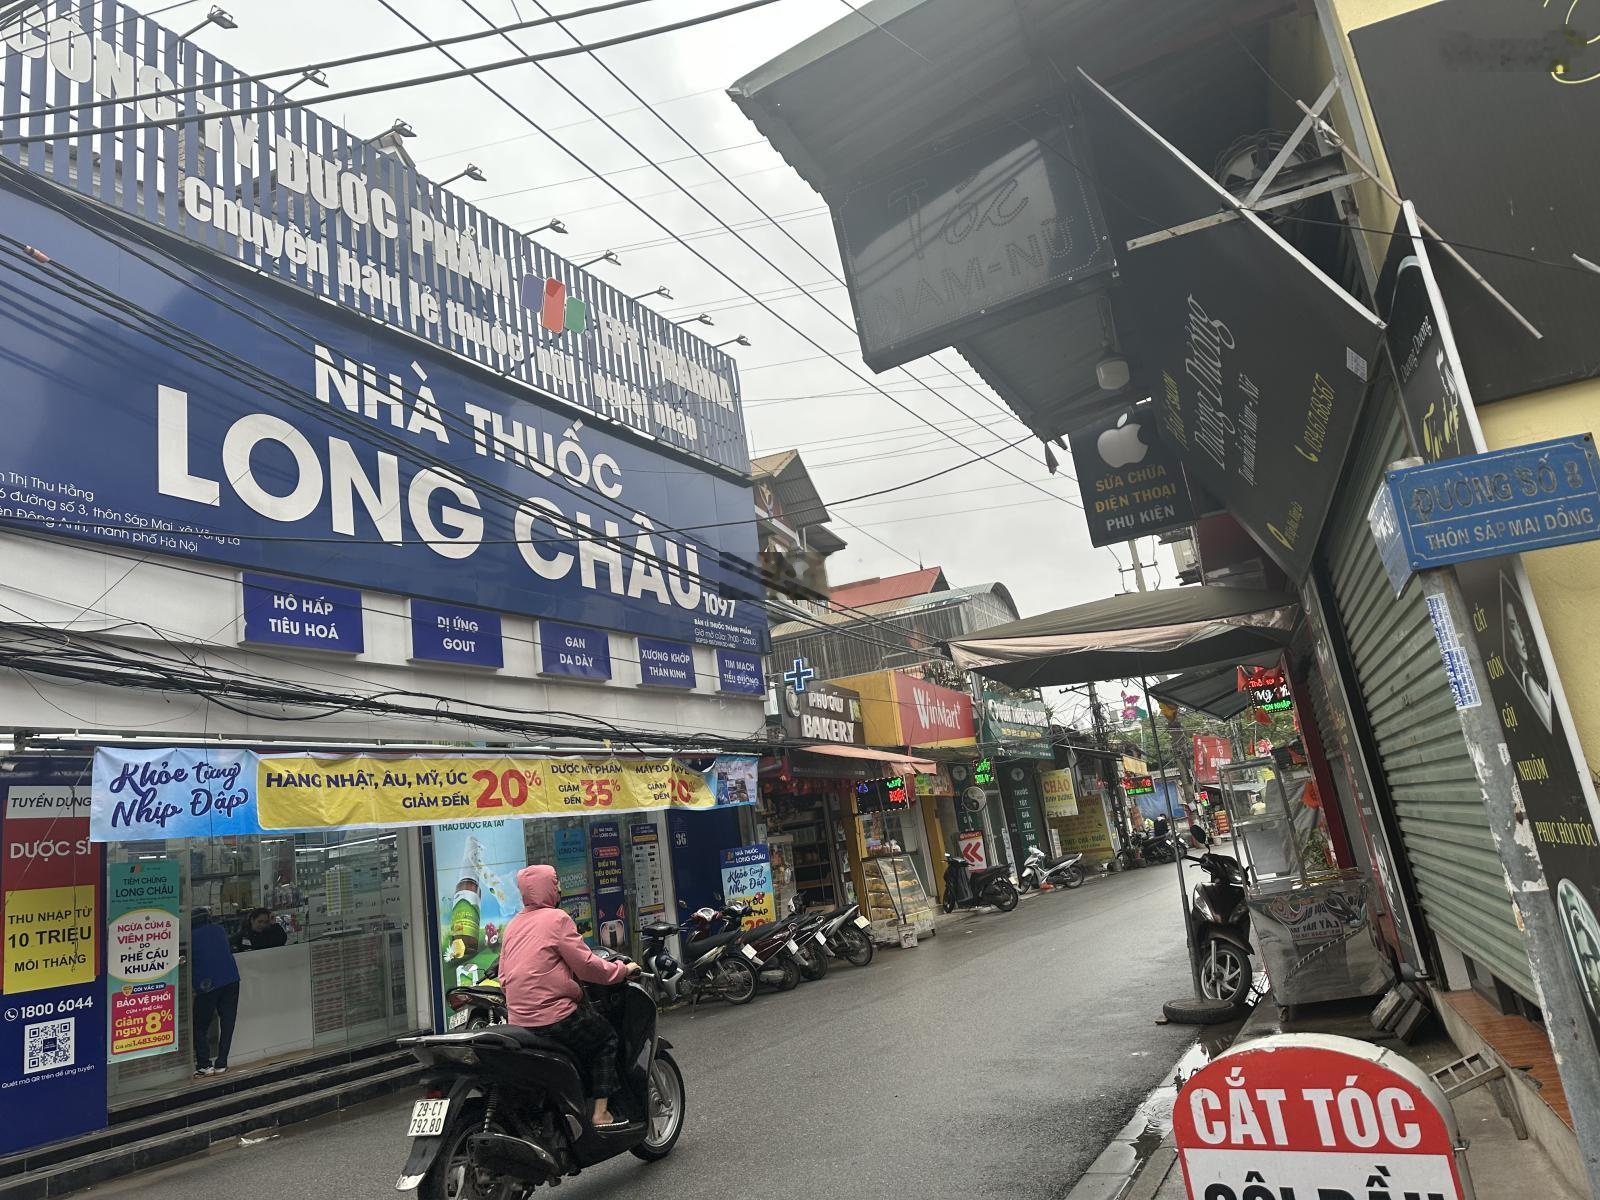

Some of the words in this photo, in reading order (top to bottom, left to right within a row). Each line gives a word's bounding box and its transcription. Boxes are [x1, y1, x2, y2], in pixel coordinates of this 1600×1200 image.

[276, 134, 398, 239] DƯỢC
[184, 176, 329, 277] Chuyên
[337, 244, 401, 307] bán
[447, 300, 524, 361] thuốc
[650, 339, 735, 413] PHARMA
[314, 344, 450, 444] NHÀ
[465, 402, 623, 499] THUỐC
[9, 471, 28, 482] Thị
[31, 476, 54, 491] Thu
[58, 483, 94, 502] Hằng
[1095, 473, 1124, 492] SỬA
[1412, 471, 1513, 519] ĐƯỜNG
[1514, 452, 1558, 497] SỐ
[158, 383, 484, 559] LONG
[514, 496, 701, 610] CHÂU
[1095, 494, 1129, 513] ĐIỆN
[1131, 483, 1177, 503] THOẠI
[10, 490, 57, 511] đường
[60, 501, 75, 513] số
[93, 507, 122, 522] thôn
[124, 512, 148, 528] Sáp
[1106, 514, 1135, 531] PHỤ
[1140, 504, 1175, 524] KIỆN
[133, 530, 157, 545] phố
[180, 541, 198, 553] Nội
[1425, 527, 1470, 550] THÔN
[1473, 519, 1506, 541] SÁP
[1508, 517, 1541, 537] MAI
[273, 593, 298, 611] HÔ
[302, 597, 333, 616] HẤP
[702, 591, 736, 618] 1097
[269, 617, 300, 635] TIÊU
[305, 623, 339, 640] HOÁ
[442, 637, 476, 653] GOUT
[565, 636, 586, 649] GAN
[560, 653, 573, 664] DA
[801, 714, 855, 743] BAKERY
[266, 770, 322, 788] HÀNG
[326, 770, 379, 790] NHẬT,
[382, 770, 412, 789] ÂU,
[416, 770, 443, 787] MỸ,
[445, 769, 469, 785] ÚC
[551, 764, 580, 777] DƯỢC
[402, 791, 439, 808] GIẢM
[441, 791, 470, 807] ĐẾN
[472, 769, 542, 809] 20%
[580, 779, 621, 807] 35%
[11, 793, 56, 808] TUYỂN
[56, 797, 92, 811] DỤNG
[111, 789, 183, 828] Nhịp
[190, 787, 249, 819] Đập
[676, 833, 686, 845] 36
[1535, 821, 1560, 848] PHỤC
[1573, 817, 1598, 847] TÓC
[10, 839, 71, 861] DƯỢC
[115, 887, 144, 898] LONG
[147, 884, 174, 896] CHÂU
[8, 914, 34, 925] THU
[38, 910, 72, 922] NHẬP
[8, 932, 30, 949] 10
[36, 925, 92, 945] TRIỆU
[42, 953, 87, 969] THÁNG
[120, 950, 143, 963] PHẾ
[20, 1002, 54, 1019] 1800
[57, 996, 94, 1012] 6044
[116, 997, 136, 1008] BẢO
[137, 994, 150, 1006] VỆ
[115, 1015, 144, 1028] Giảm
[145, 1009, 173, 1034] 8%
[115, 1026, 144, 1038] ngay
[417, 1101, 444, 1117] 29-C1
[1189, 1066, 1289, 1146] CẮT
[1301, 1075, 1422, 1150] TÓC
